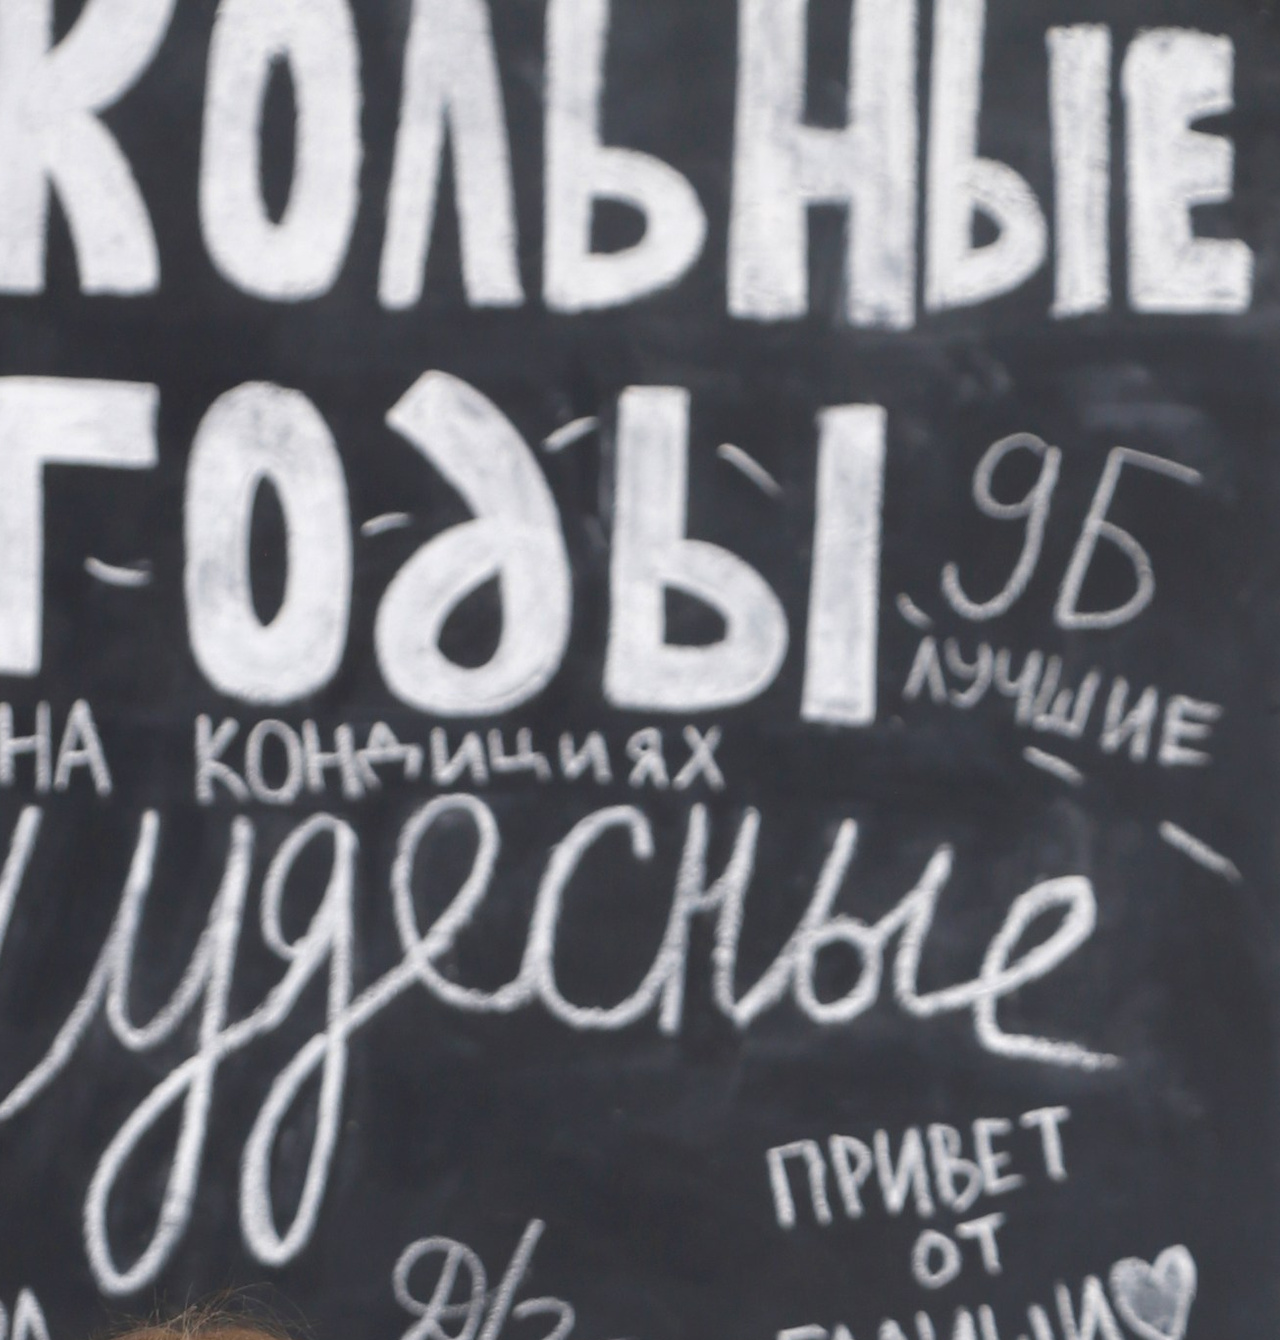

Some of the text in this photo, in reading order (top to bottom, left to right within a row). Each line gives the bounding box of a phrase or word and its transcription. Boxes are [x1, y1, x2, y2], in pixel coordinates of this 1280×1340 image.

[940, 431, 1204, 628] 9Б
[194, 712, 724, 804] КОНДИЦИЯХ
[904, 634, 1223, 767] ЛУЧШИЕ
[765, 1105, 1071, 1229] ПРИВЕТ
[911, 1211, 1006, 1290] ОТ
